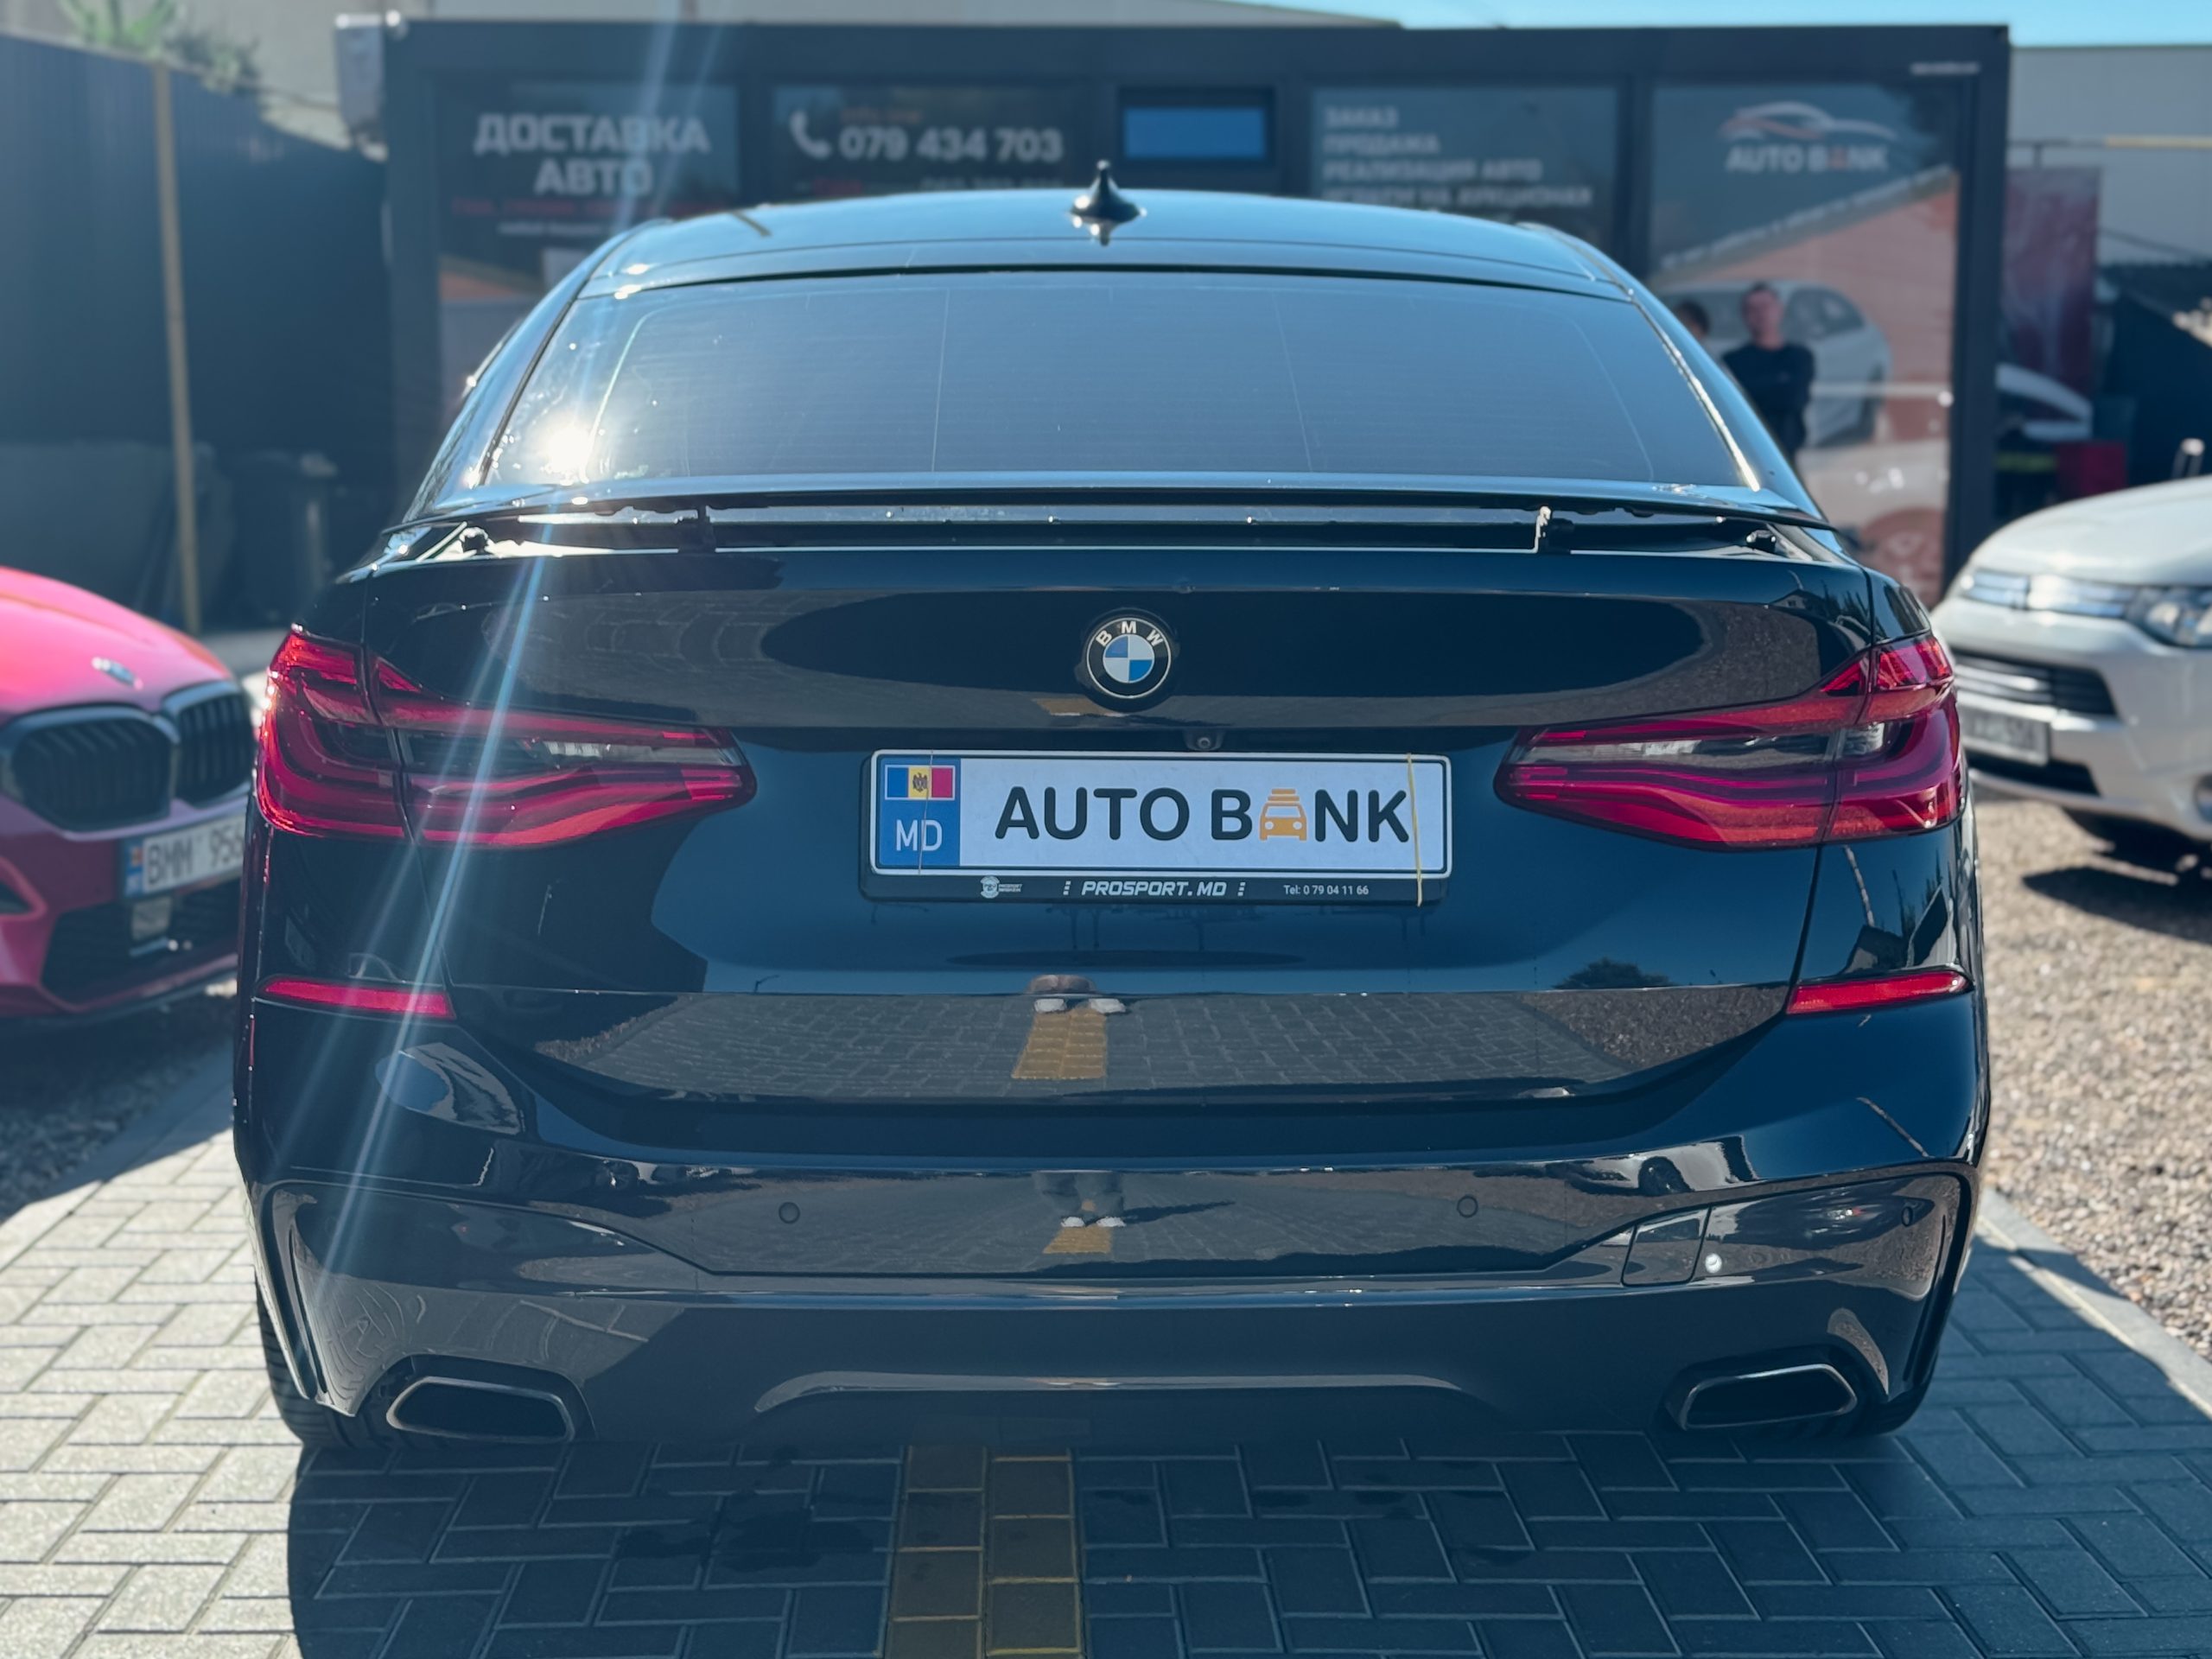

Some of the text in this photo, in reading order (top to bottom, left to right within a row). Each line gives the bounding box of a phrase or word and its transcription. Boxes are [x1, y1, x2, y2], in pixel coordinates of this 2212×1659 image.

[474, 114, 711, 156] ДОСТАВКА
[838, 127, 1064, 162] 079 434 703
[1726, 144, 1803, 172] AUTO
[534, 158, 652, 195] АВТО
[1096, 620, 1164, 646] BMW
[995, 786, 1190, 841] AUTO
[896, 819, 943, 851] MD
